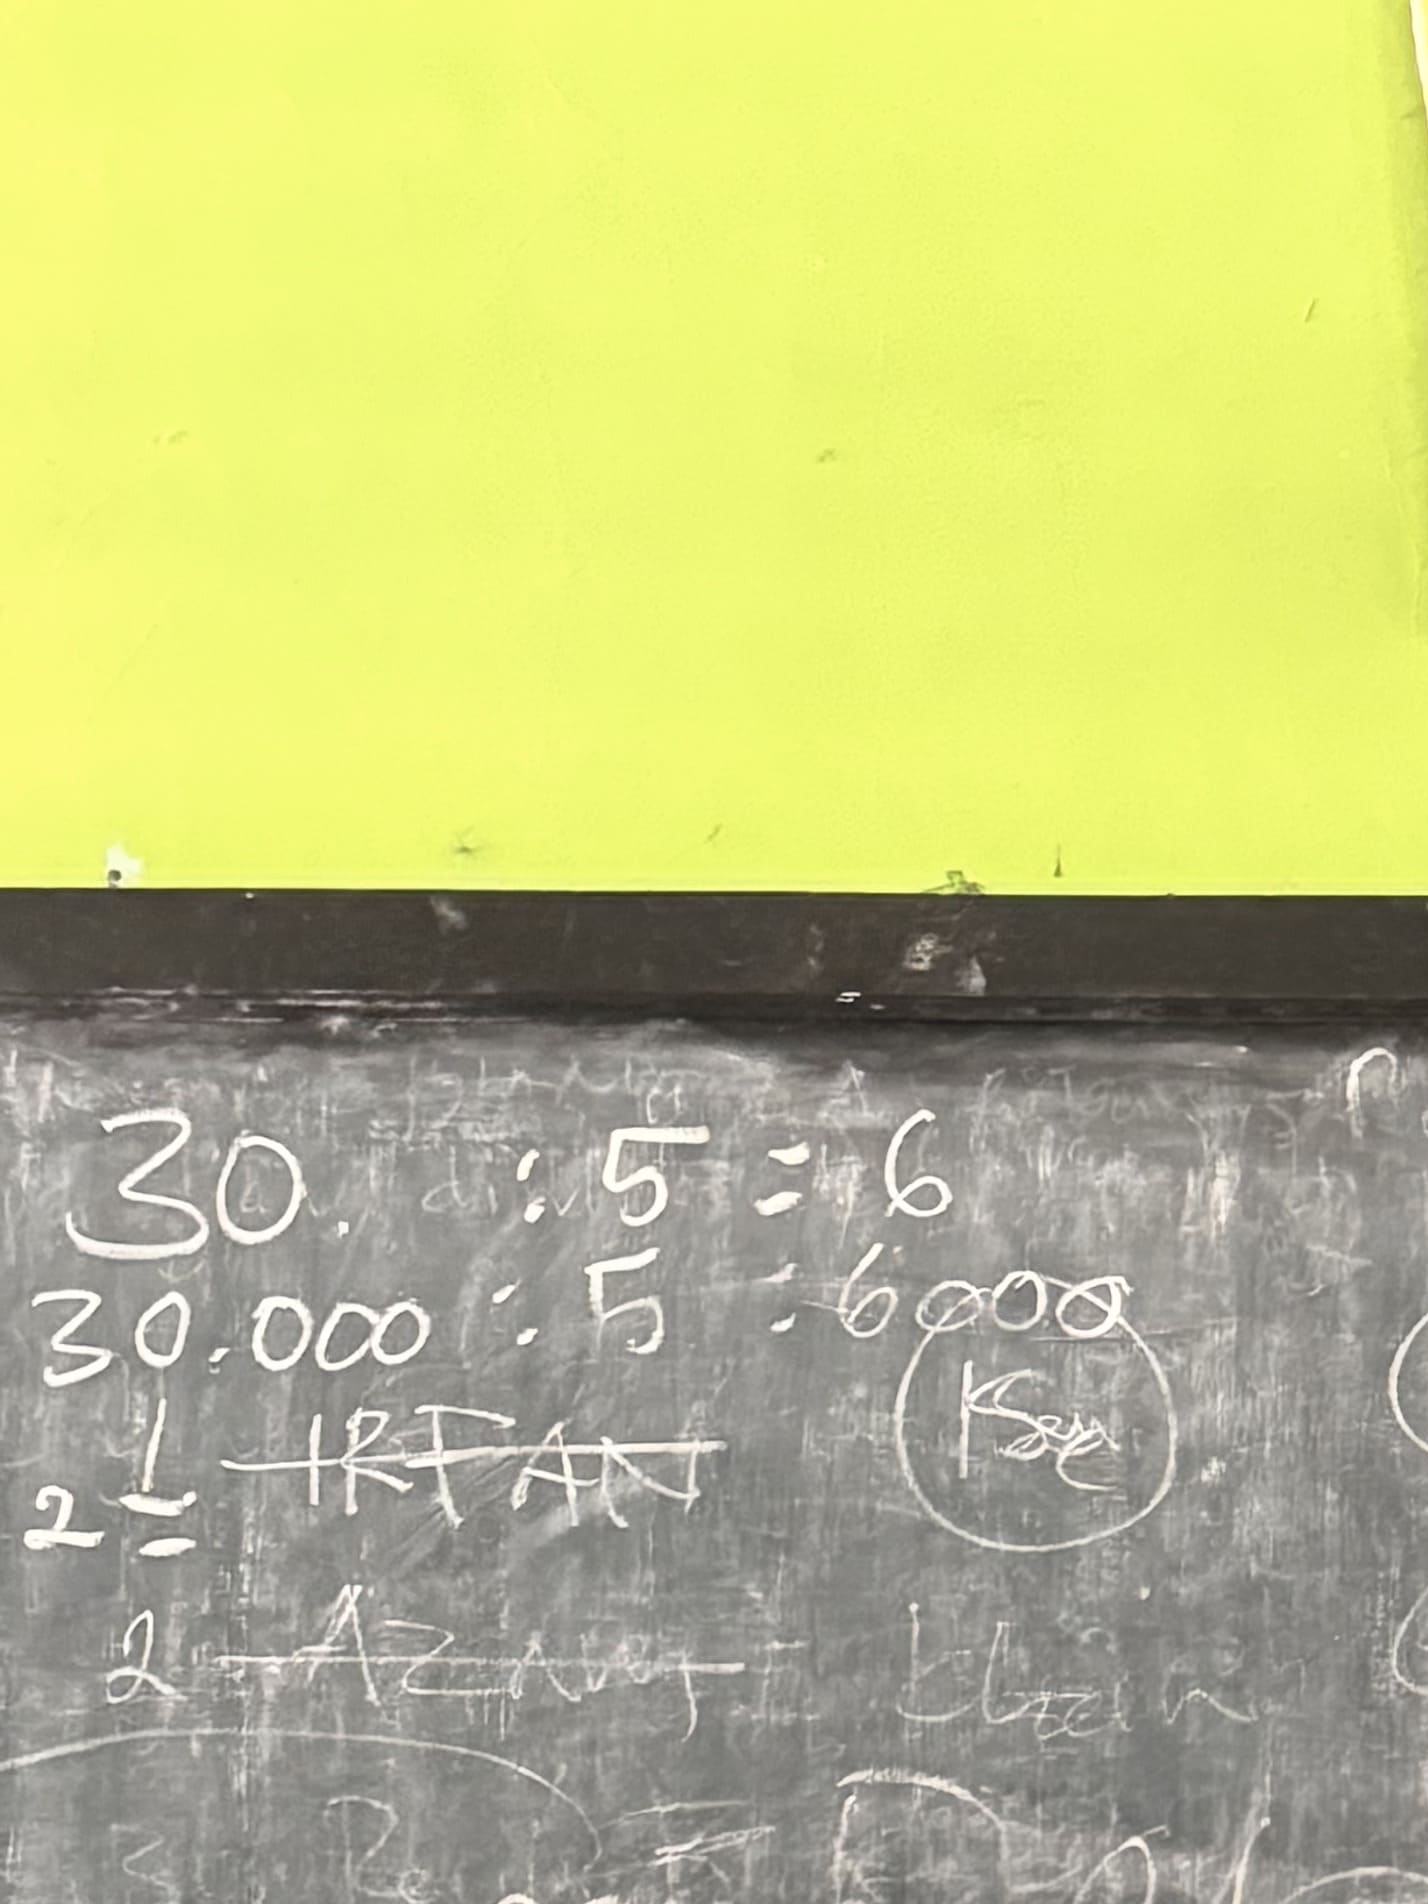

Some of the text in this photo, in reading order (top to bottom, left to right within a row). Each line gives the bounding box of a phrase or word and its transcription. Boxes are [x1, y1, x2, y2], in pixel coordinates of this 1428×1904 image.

[603, 1124, 710, 1227] 5
[884, 1108, 953, 1218] 6
[30, 1288, 432, 1388] 30.000
[584, 1246, 664, 1354] 5
